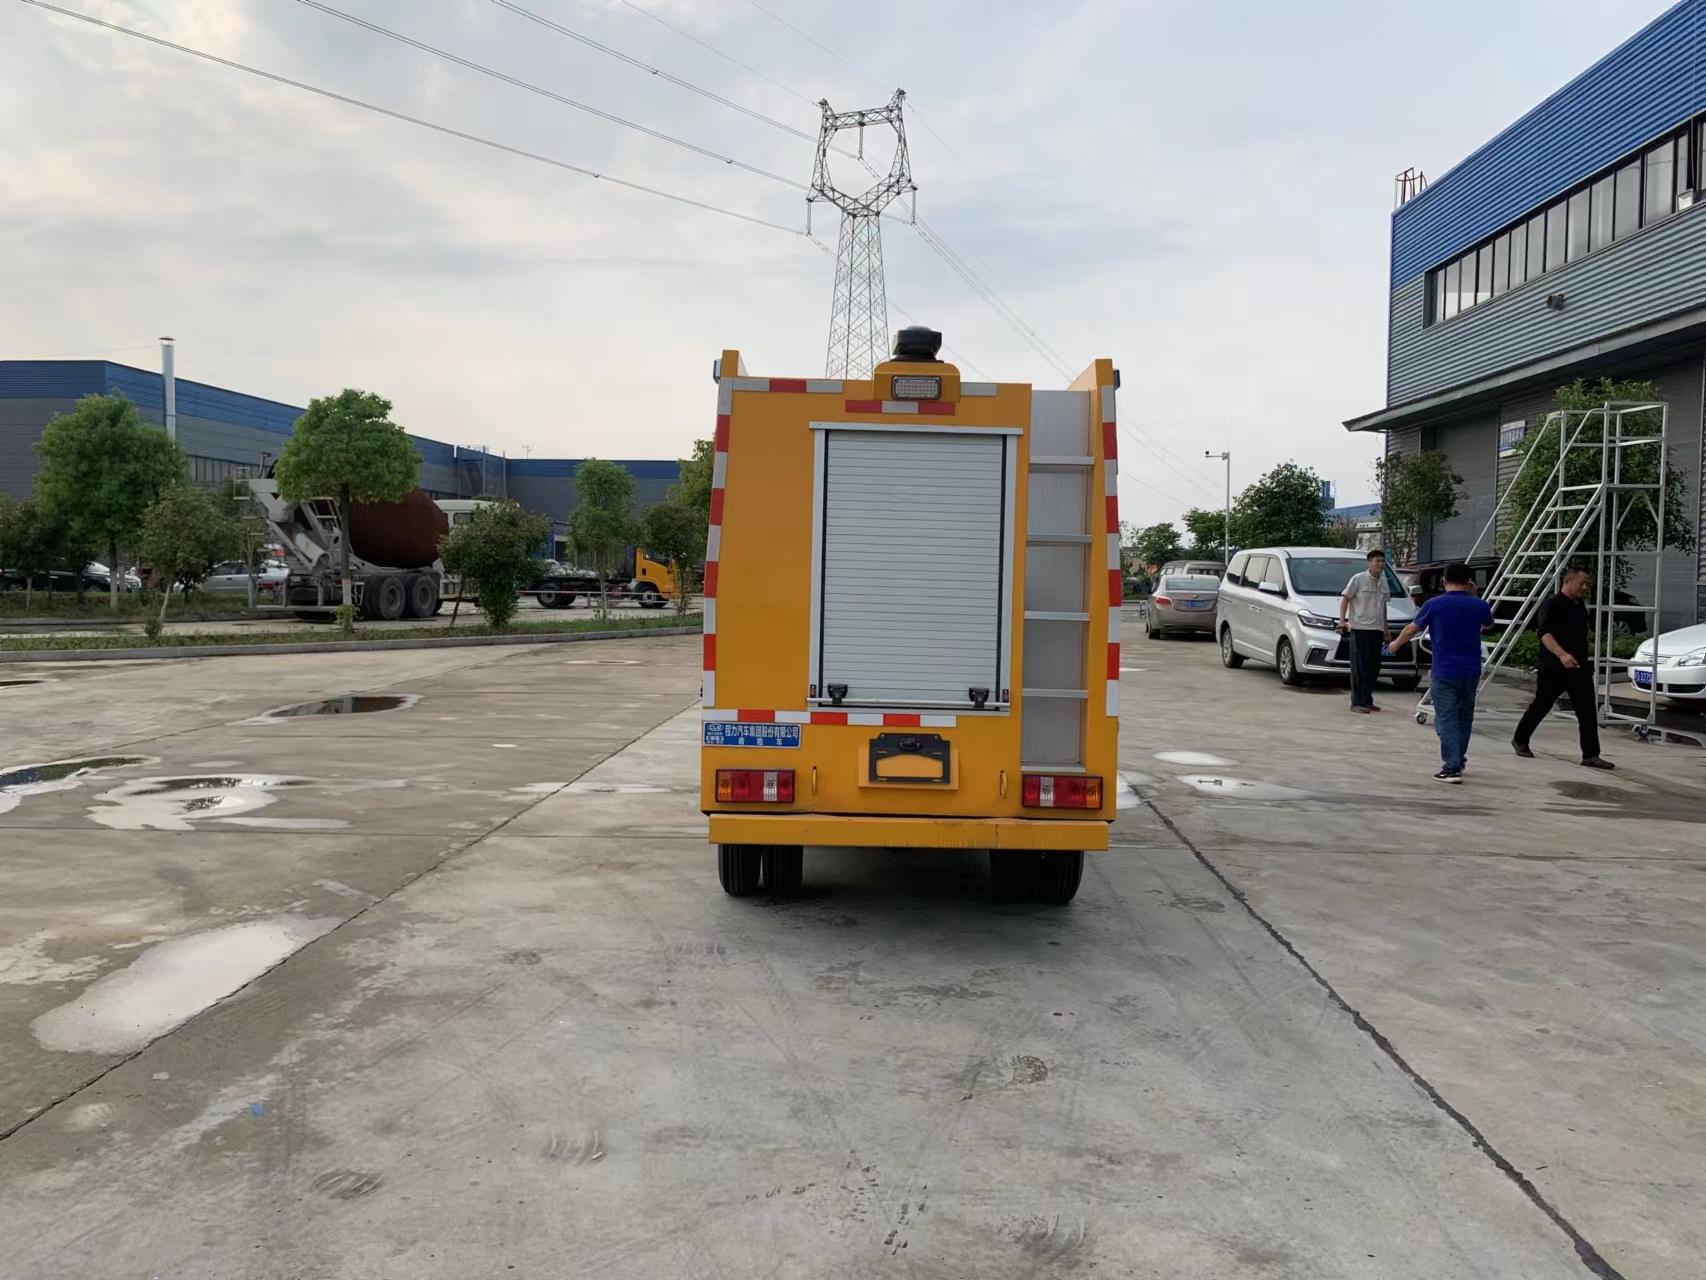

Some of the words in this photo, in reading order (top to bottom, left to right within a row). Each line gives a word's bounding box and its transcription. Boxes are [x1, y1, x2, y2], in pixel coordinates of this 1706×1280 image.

[725, 725, 798, 738] 程力汽车集团股份有限公司
